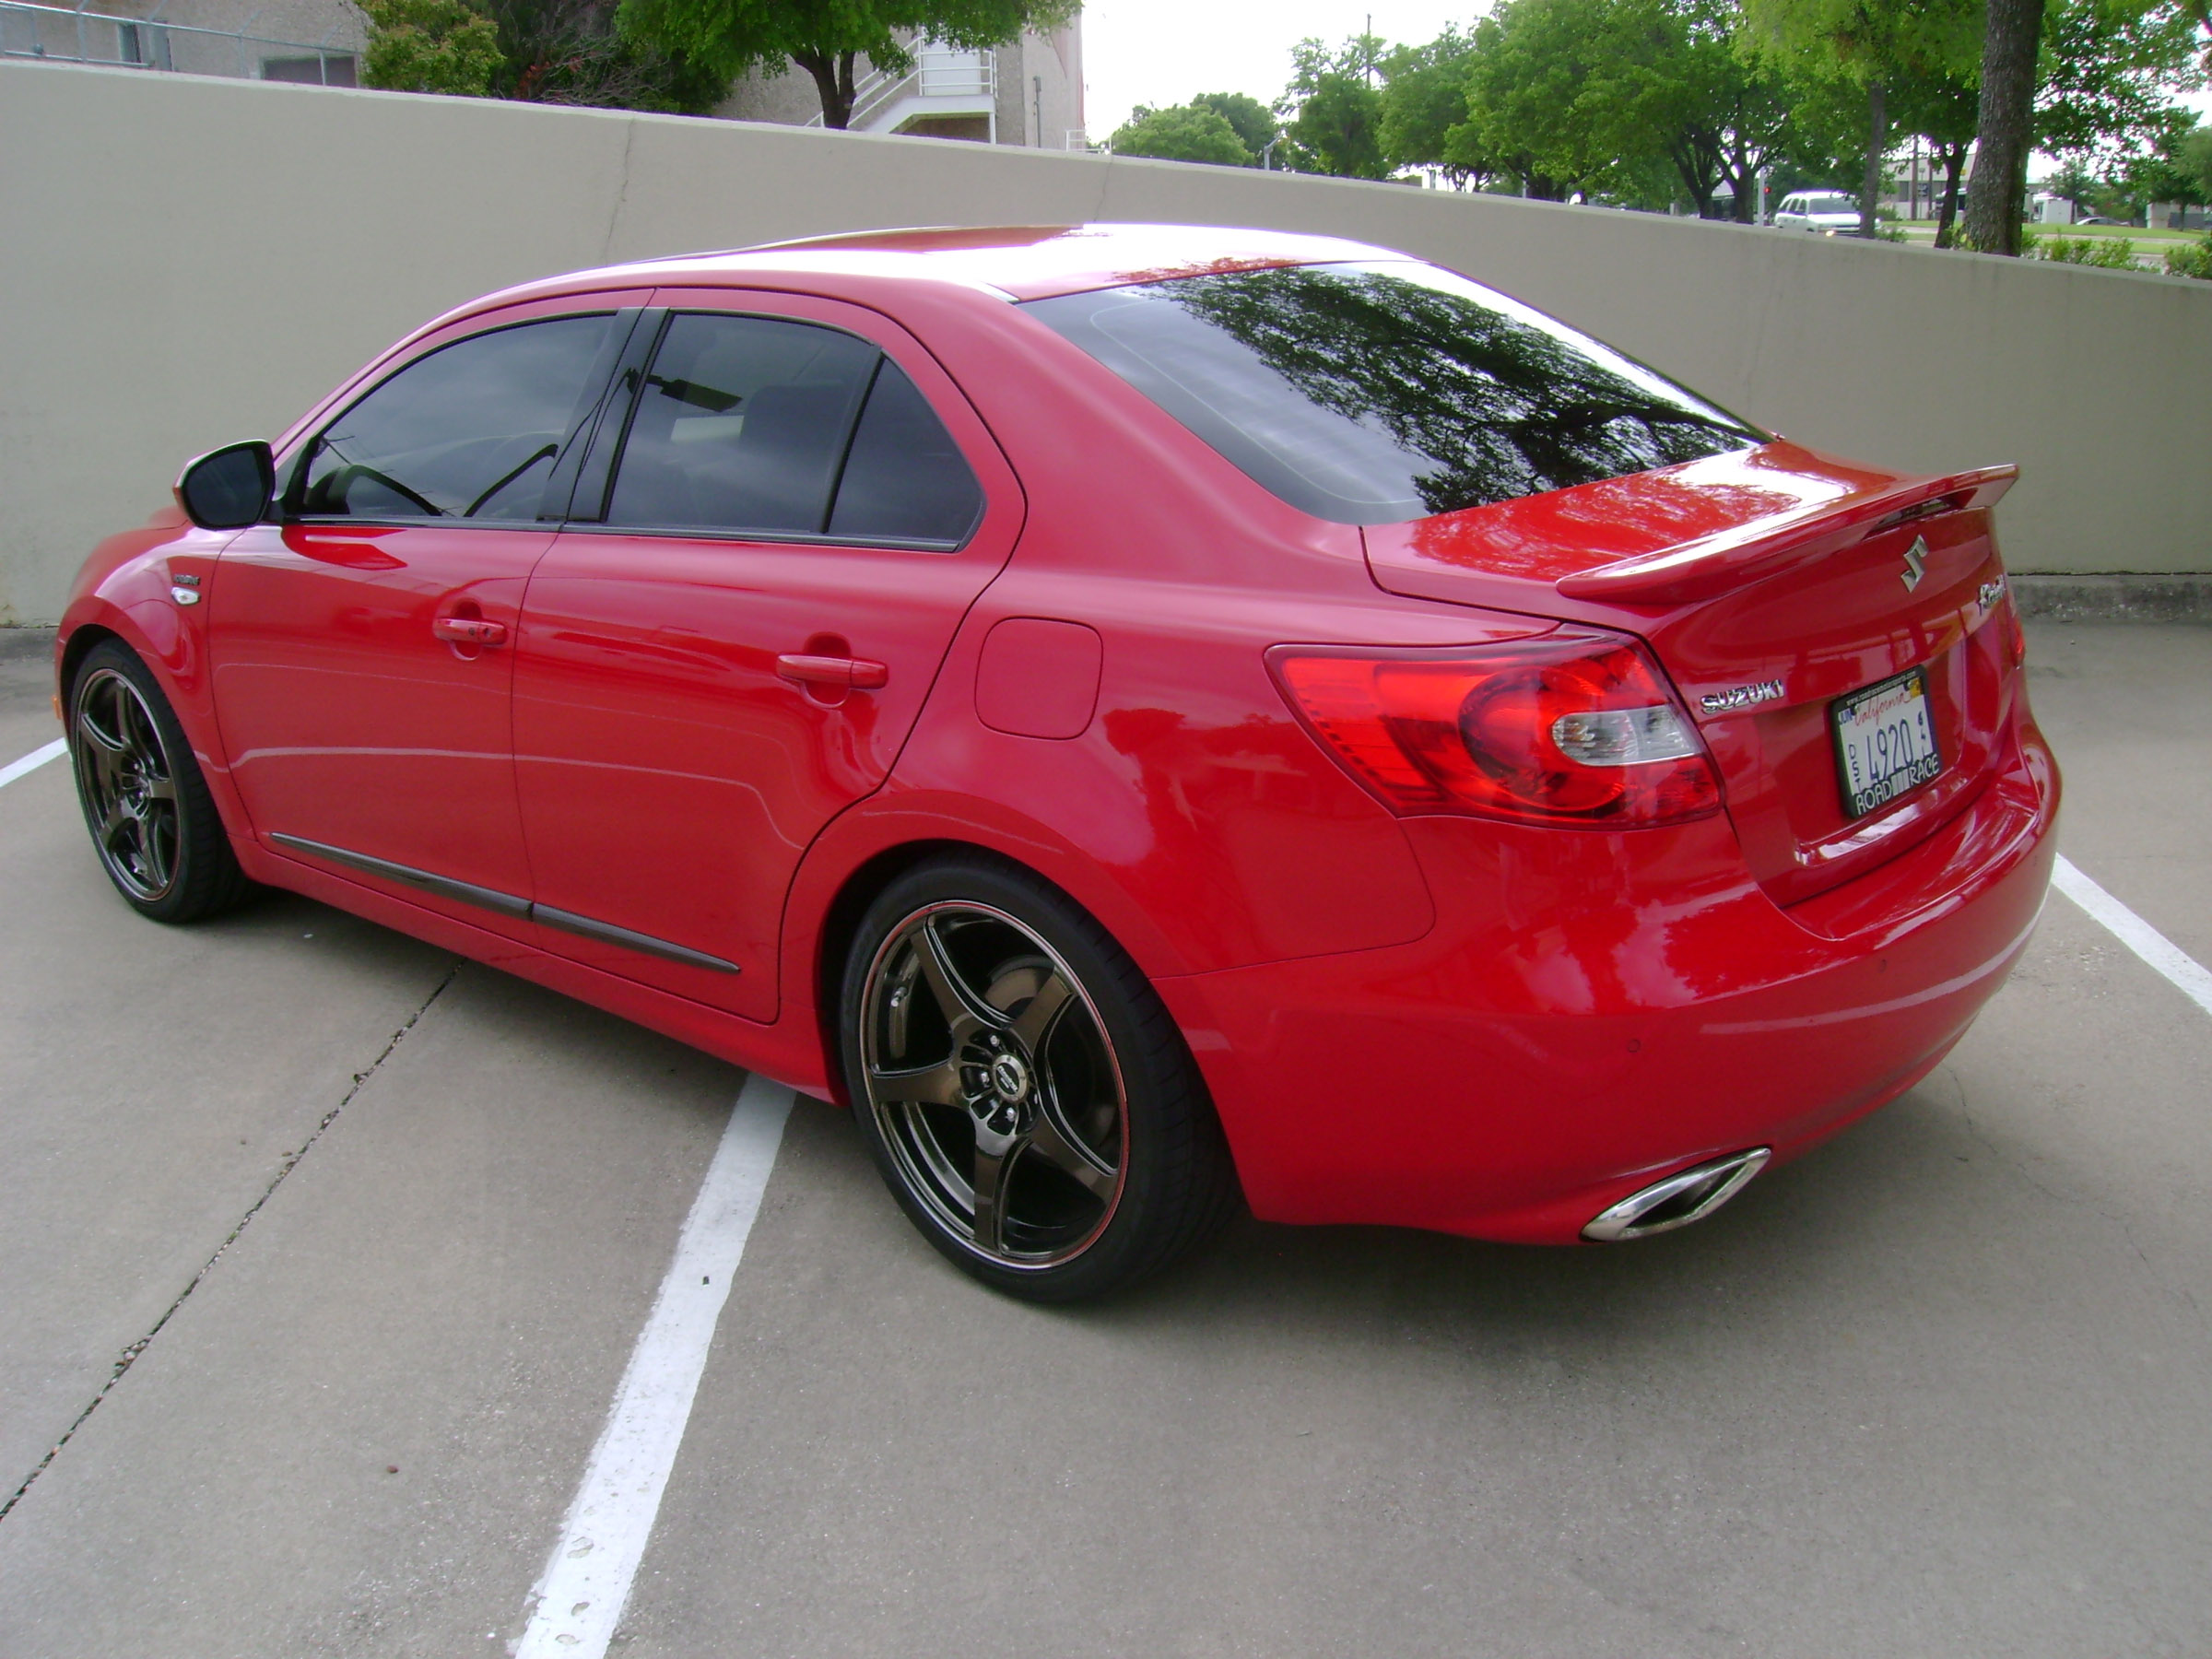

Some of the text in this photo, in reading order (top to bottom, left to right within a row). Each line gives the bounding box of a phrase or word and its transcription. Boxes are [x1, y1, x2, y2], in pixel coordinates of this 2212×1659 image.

[1700, 678, 1784, 714] SUZUKI
[1854, 688, 1912, 727] California
[1866, 718, 1914, 783] 4920
[1855, 753, 1940, 816] ROAD RACE
